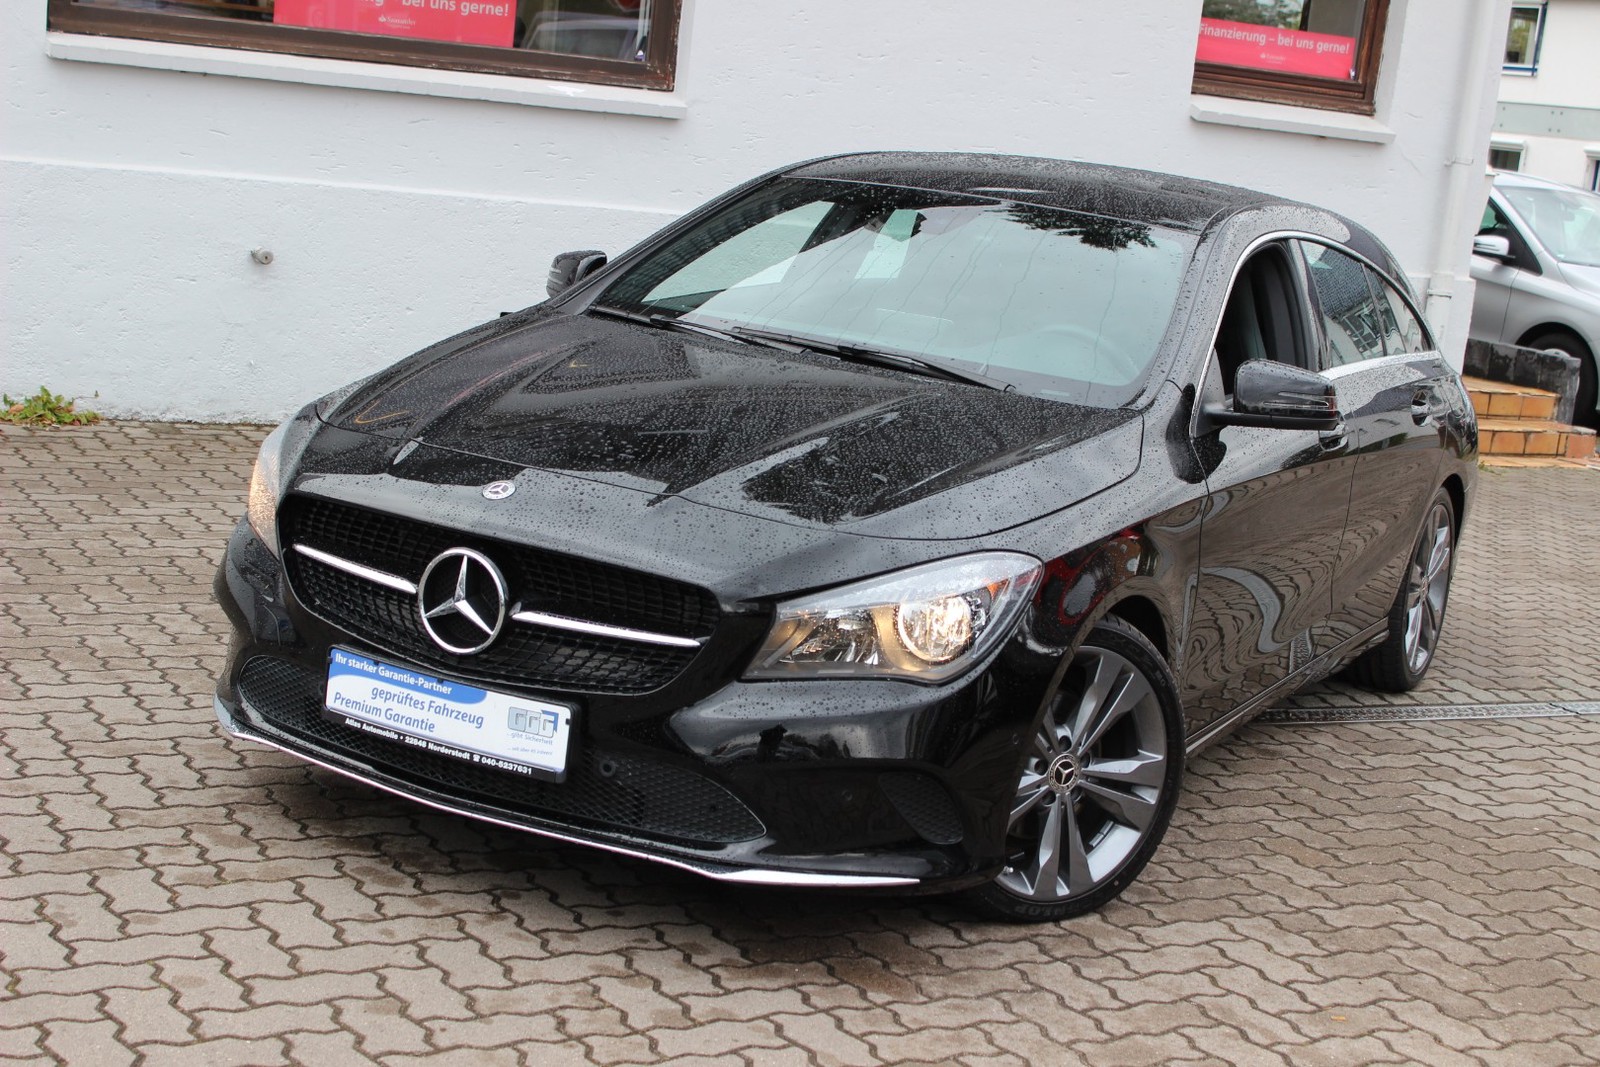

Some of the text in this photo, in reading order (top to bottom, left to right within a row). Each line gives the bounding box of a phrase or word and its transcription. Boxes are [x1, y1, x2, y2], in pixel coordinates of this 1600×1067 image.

[430, 0, 456, 11] uns
[460, 1, 509, 16] gerne!
[1199, 23, 1266, 46] Finanzierung
[1278, 34, 1294, 46] bei
[1296, 38, 1314, 49] uns
[1317, 42, 1350, 54] gerne!
[335, 653, 453, 695] Ihr starker Garantie-Partner
[334, 692, 436, 733] Premium Garantie
[371, 686, 485, 729] geprüftes Fahrzeug
[362, 723, 399, 740] Automobile
[428, 742, 470, 760] Norderstedt
